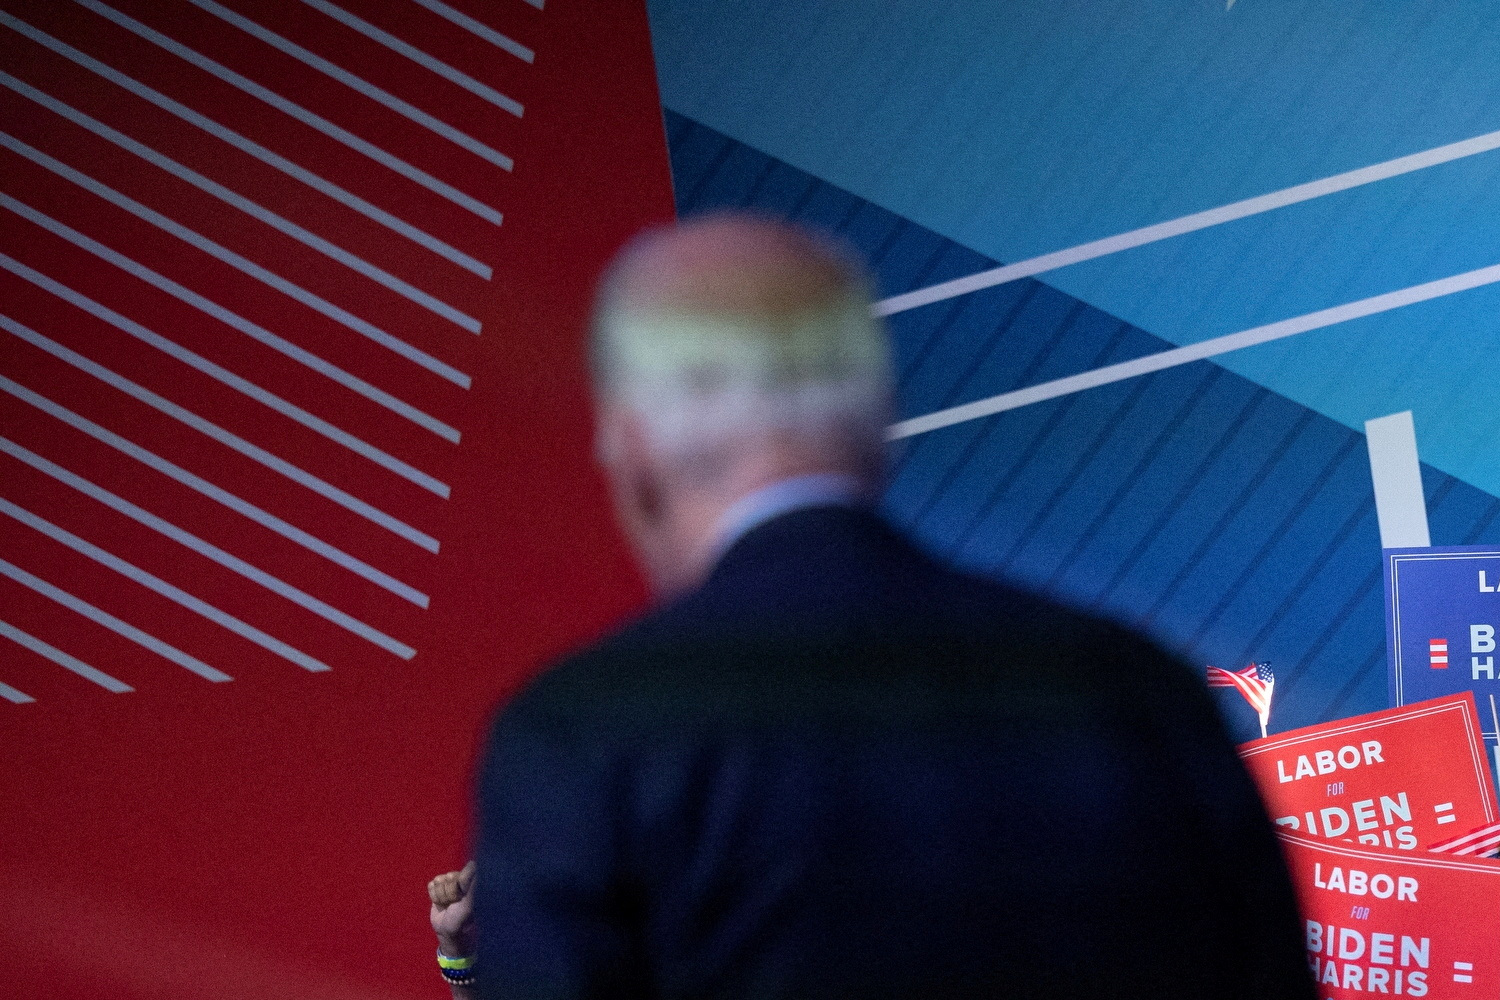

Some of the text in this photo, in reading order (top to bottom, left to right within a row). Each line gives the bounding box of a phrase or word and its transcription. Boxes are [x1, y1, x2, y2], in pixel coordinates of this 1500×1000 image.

[1277, 740, 1385, 783] LABOR
[1327, 782, 1344, 797] FOR
[1314, 863, 1419, 902] LABOR
[1350, 906, 1370, 920] FOR
[1306, 919, 1430, 969] BIDEN
